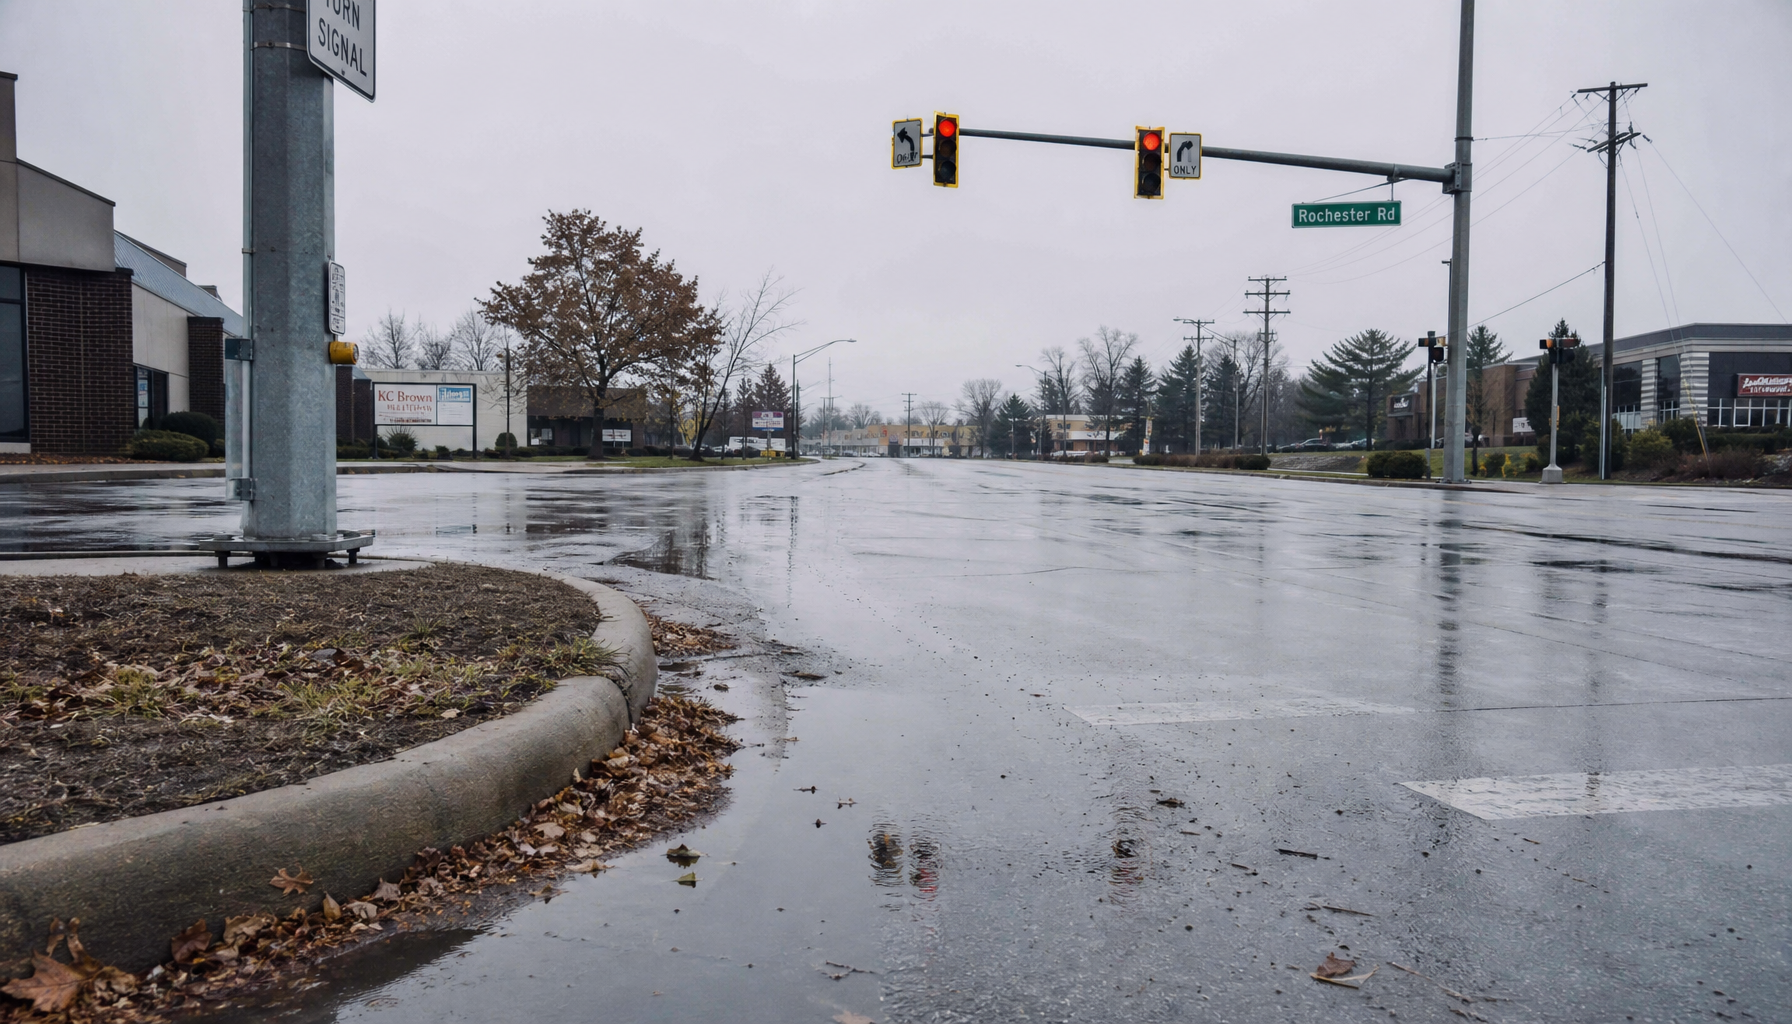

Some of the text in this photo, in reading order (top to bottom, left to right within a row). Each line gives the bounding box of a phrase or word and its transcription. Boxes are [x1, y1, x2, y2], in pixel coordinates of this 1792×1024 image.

[326, 0, 360, 31] URN
[318, 17, 367, 77] SIGNAL
[1173, 165, 1197, 175] ONLY
[1298, 206, 1395, 222] Rochester Rd
[378, 390, 394, 402] KC
[397, 390, 433, 403] Brown
